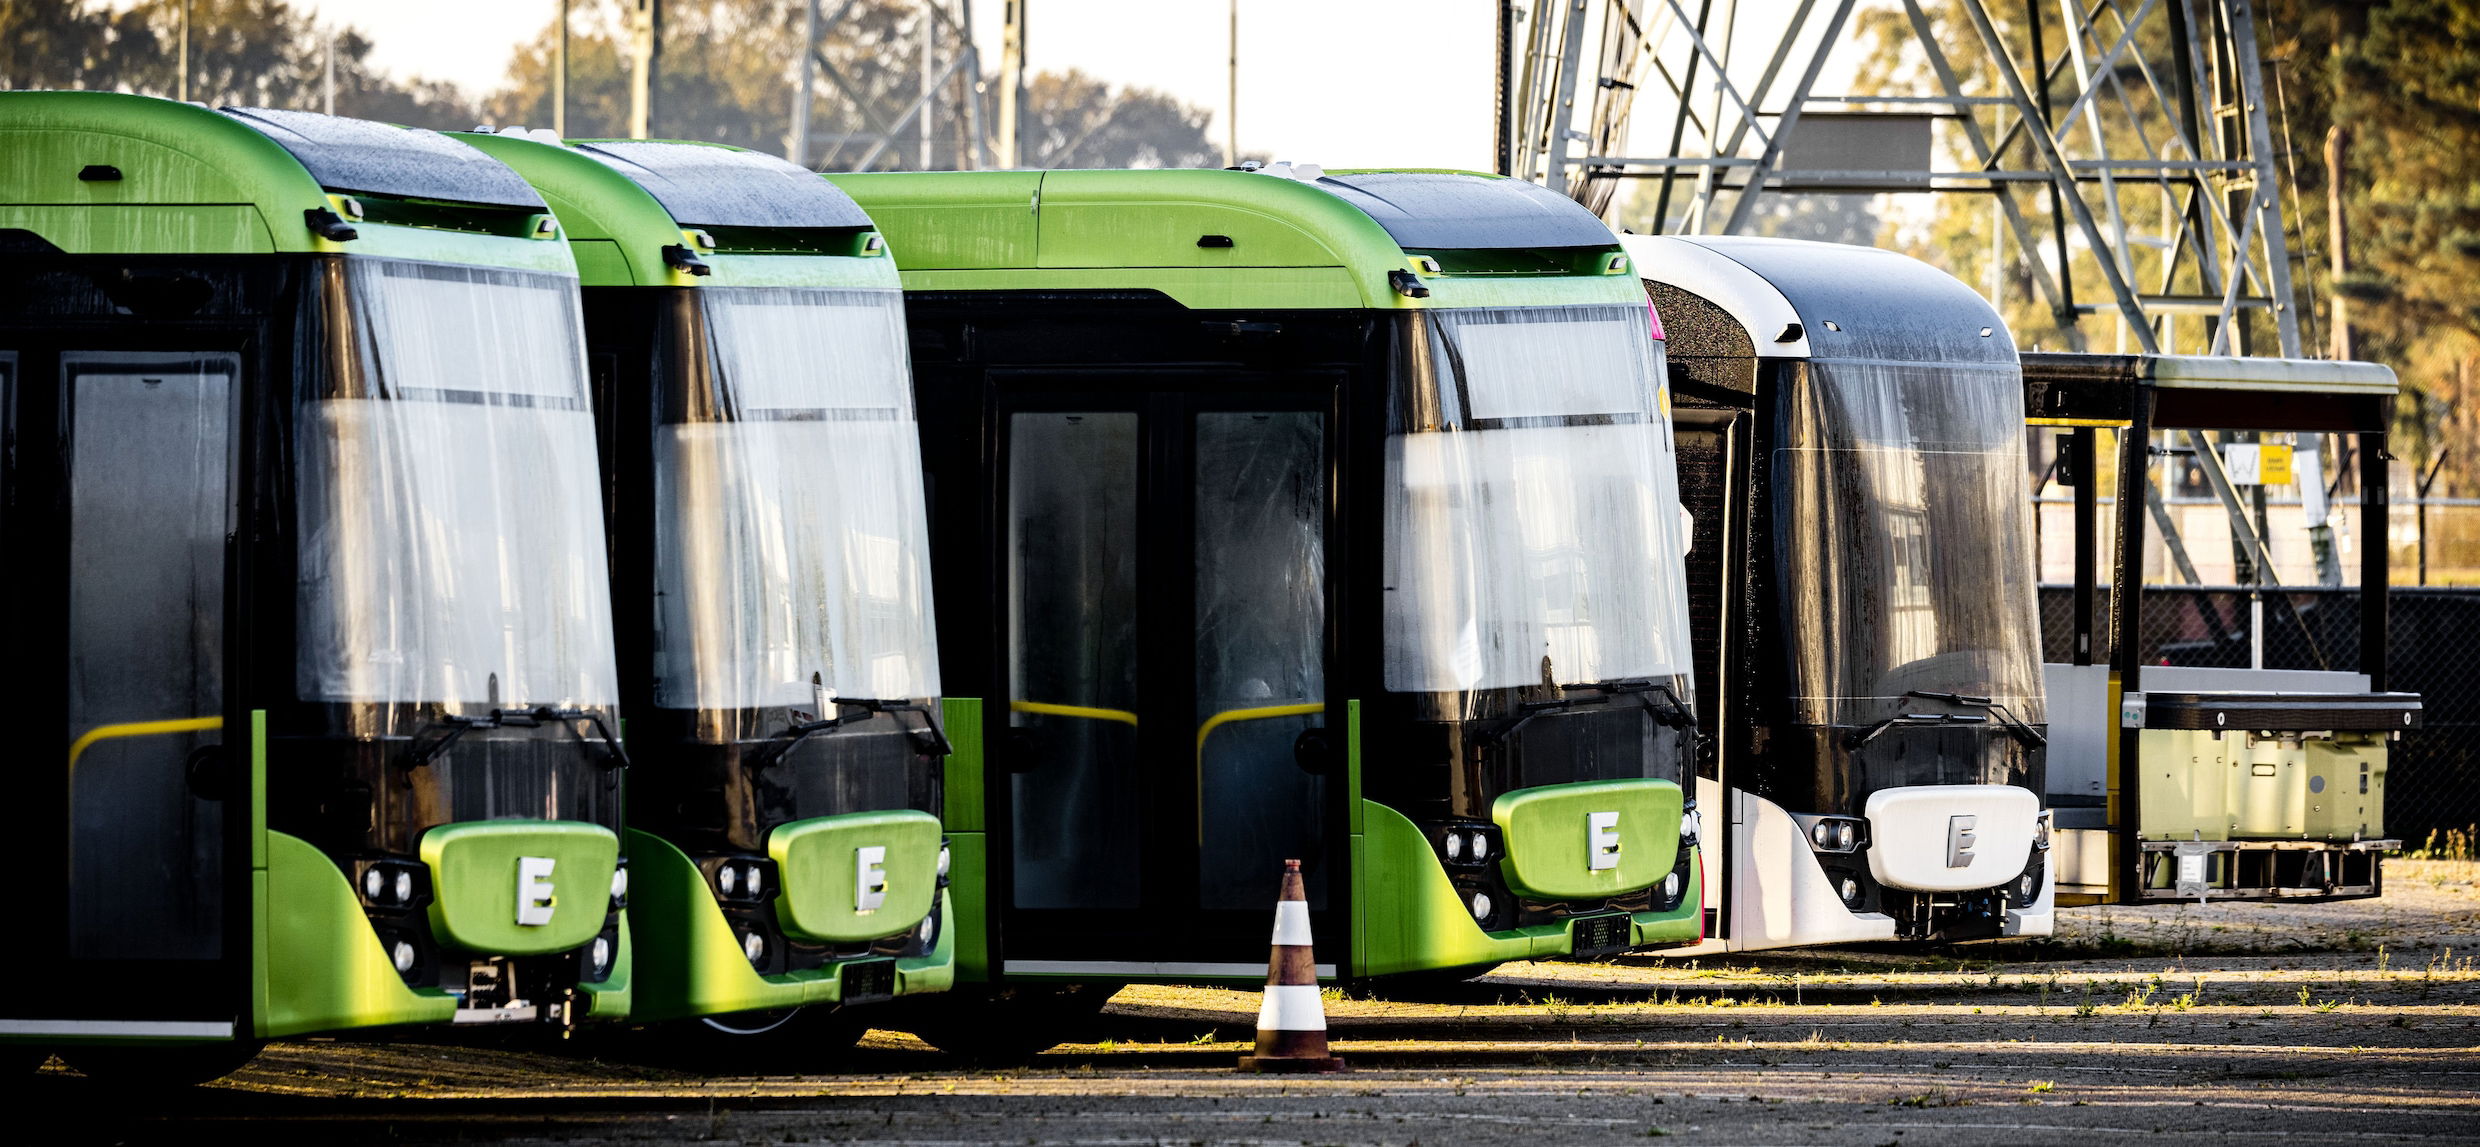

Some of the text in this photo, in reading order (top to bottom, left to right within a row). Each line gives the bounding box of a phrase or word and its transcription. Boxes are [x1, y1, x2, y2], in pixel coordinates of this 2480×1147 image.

[1587, 812, 1621, 871] E
[1947, 815, 1977, 868] E
[515, 856, 556, 926] E
[854, 846, 886, 911] E
